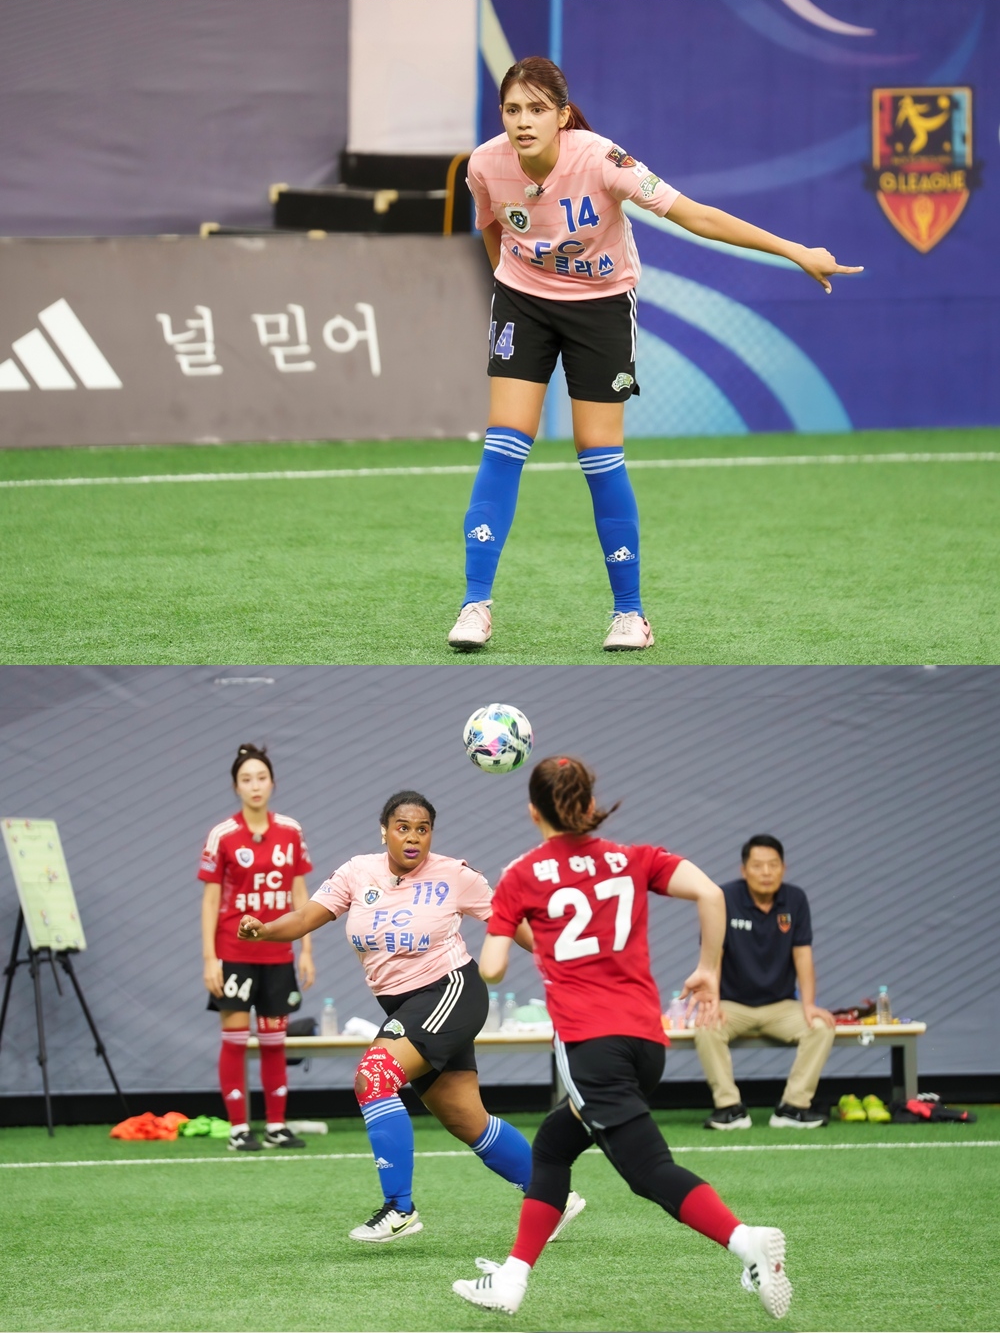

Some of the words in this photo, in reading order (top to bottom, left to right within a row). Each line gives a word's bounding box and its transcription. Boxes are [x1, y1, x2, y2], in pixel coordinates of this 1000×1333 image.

[559, 195, 600, 234] 14
[156, 304, 224, 376] 널
[251, 302, 381, 377] 믿어
[254, 870, 284, 891] FC
[413, 881, 450, 907] 119
[373, 909, 413, 931] FC
[547, 879, 635, 963] 27
[224, 973, 253, 1002] 64
